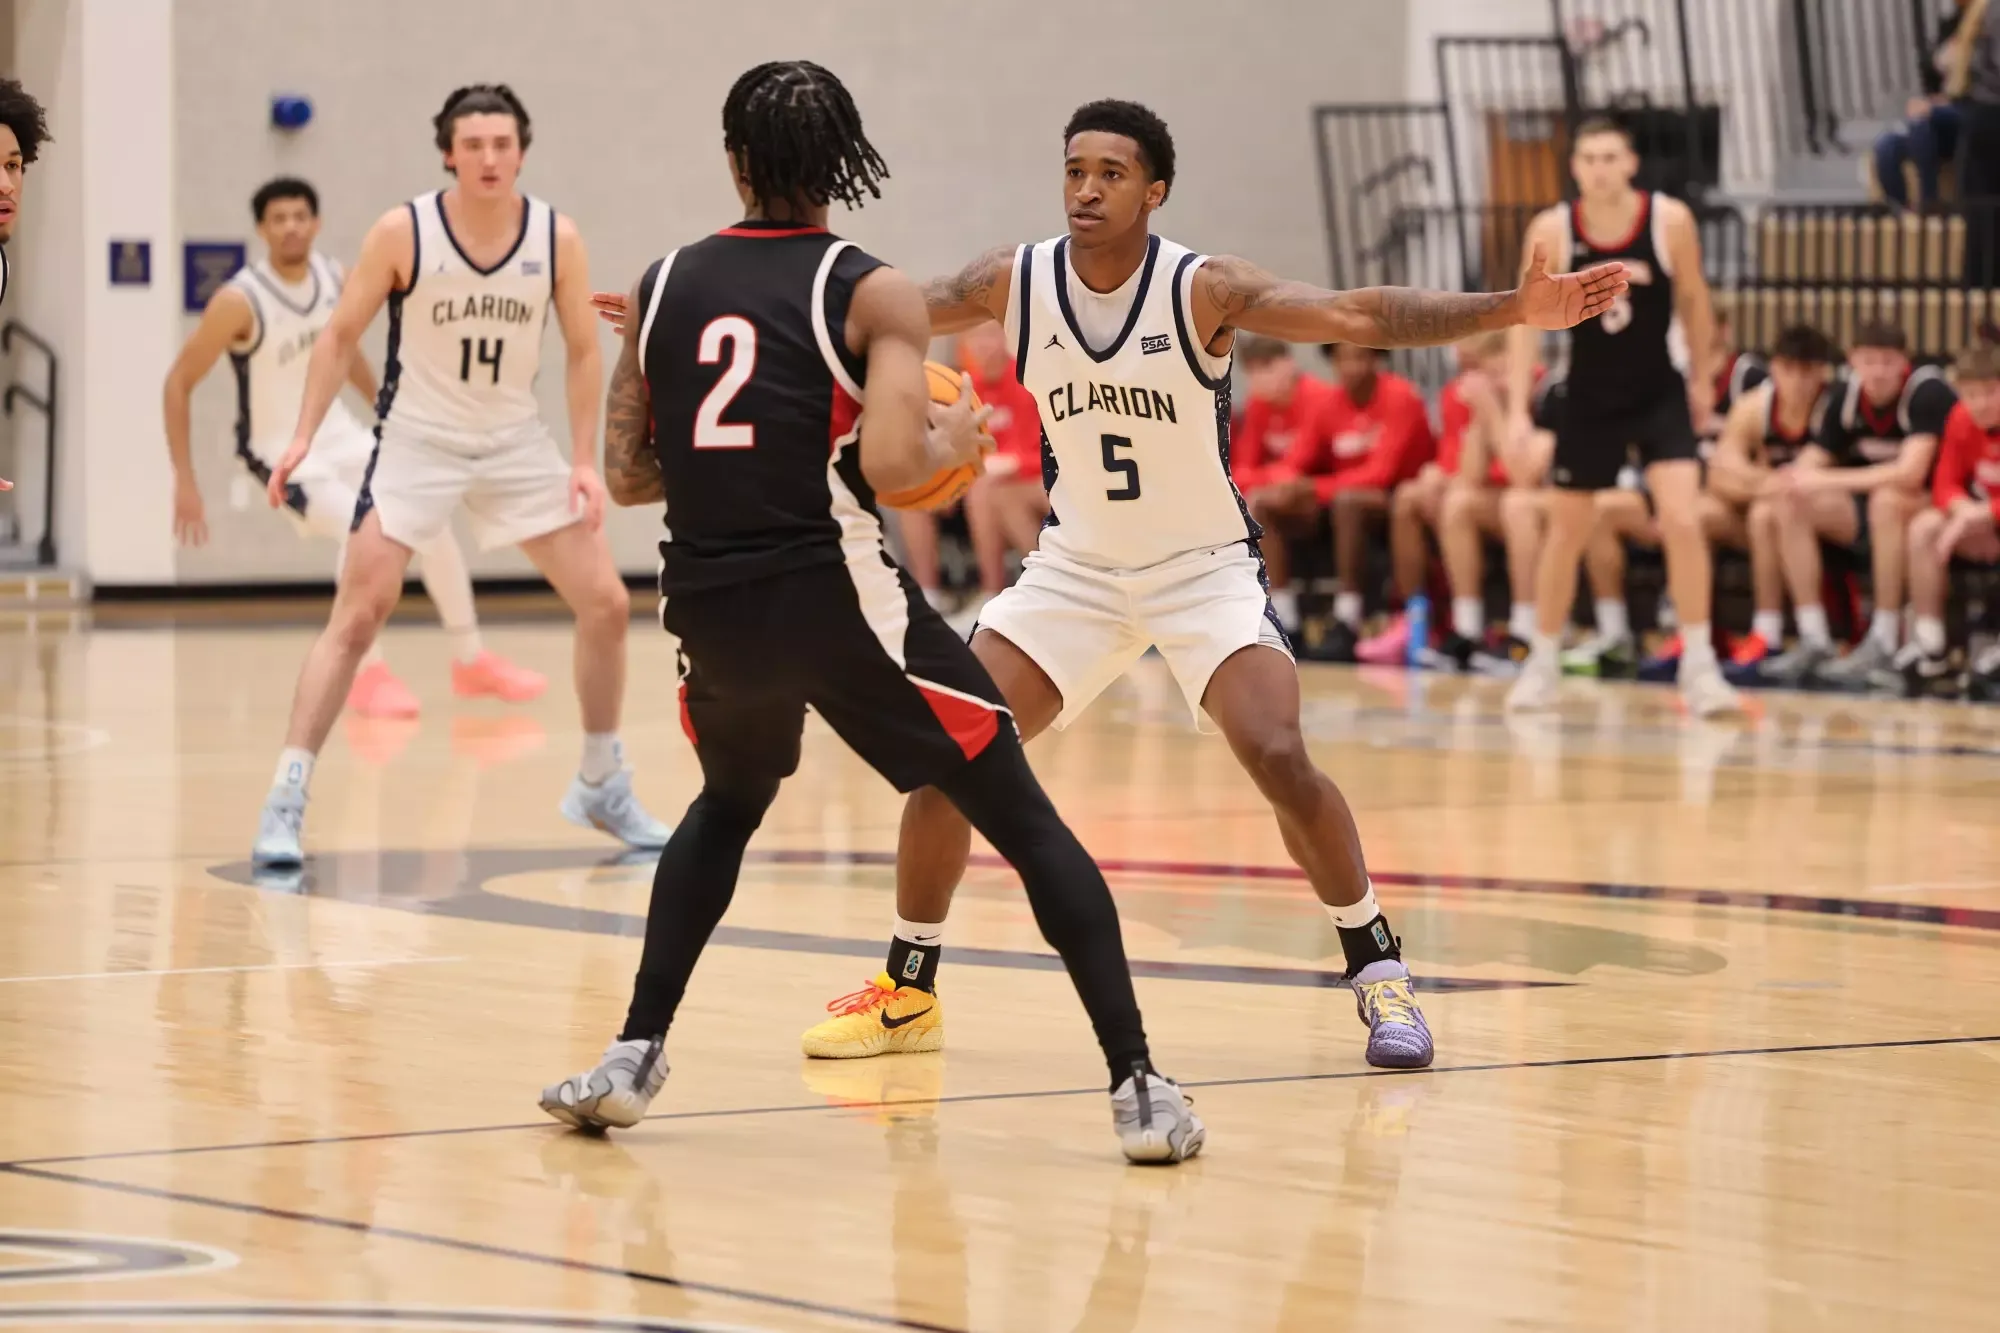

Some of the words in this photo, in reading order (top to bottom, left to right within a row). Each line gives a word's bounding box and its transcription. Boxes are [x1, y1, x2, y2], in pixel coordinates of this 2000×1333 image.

[432, 294, 533, 327] CLARION
[459, 336, 504, 386] 14
[1141, 336, 1172, 352] PSAC
[692, 313, 758, 451] 2
[1048, 381, 1178, 424] CLARION
[1101, 433, 1141, 501] 5
